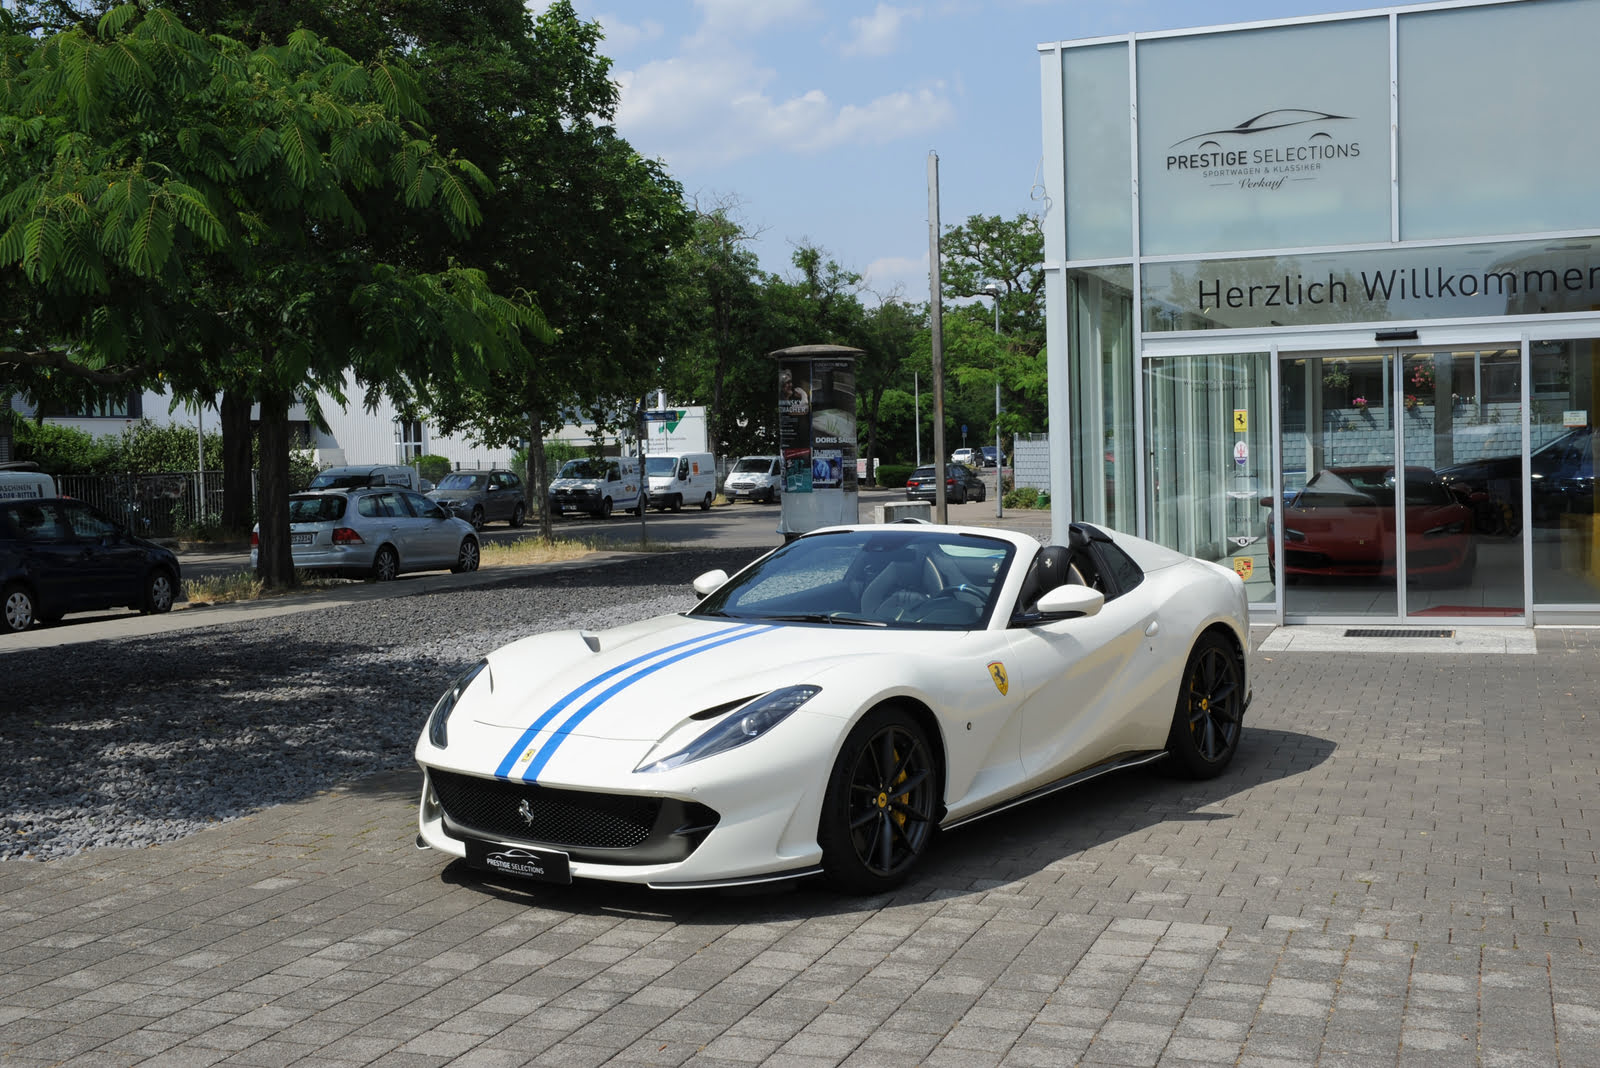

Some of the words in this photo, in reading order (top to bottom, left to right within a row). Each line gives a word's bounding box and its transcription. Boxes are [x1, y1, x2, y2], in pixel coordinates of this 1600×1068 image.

[1167, 150, 1248, 170] PRESTIGE
[1253, 143, 1360, 164] SELECTIONS
[1203, 167, 1261, 178] SPORTWAGEN
[1273, 162, 1321, 173] KLASSIKER
[1239, 176, 1288, 190] Verkauf
[1199, 273, 1347, 310] Herzlich
[486, 858, 511, 869] PRESTIGE
[511, 862, 545, 875] SELECTIONS
